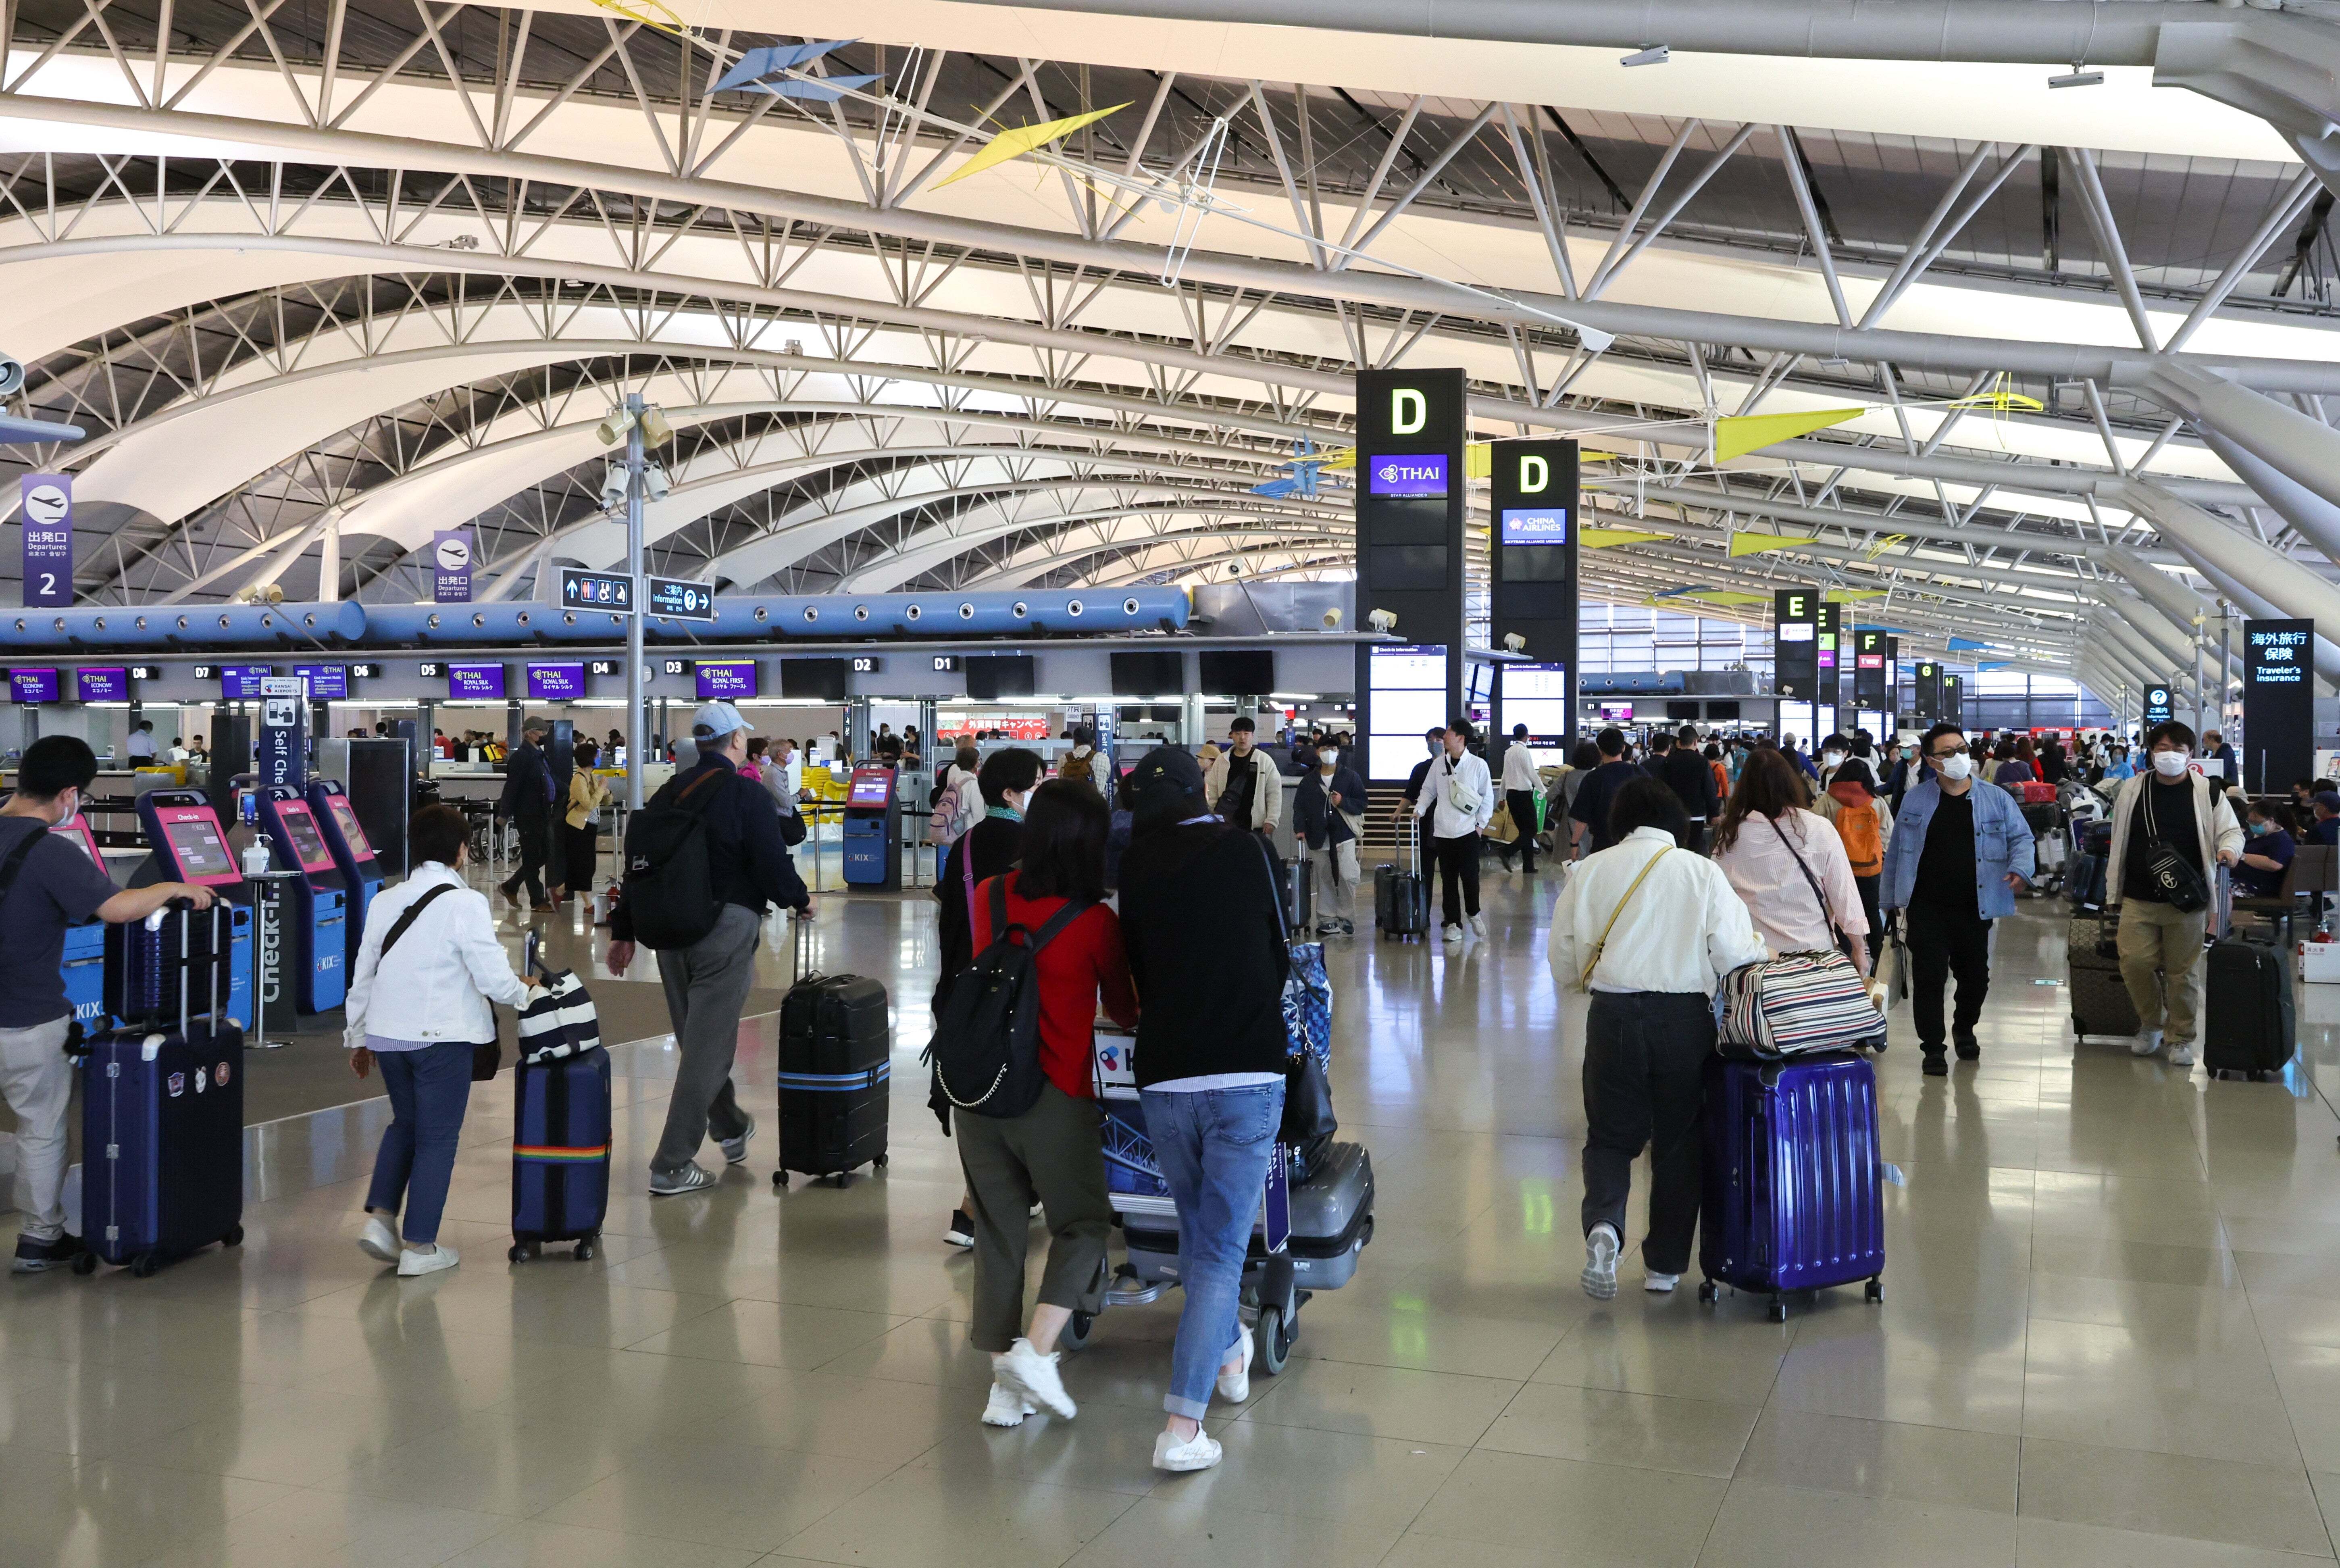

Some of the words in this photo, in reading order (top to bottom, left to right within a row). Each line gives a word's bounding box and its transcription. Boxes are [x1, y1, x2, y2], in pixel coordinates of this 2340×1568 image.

[1393, 389, 1426, 434] D
[1399, 467, 1439, 479] THAI
[1520, 456, 1548, 493] D
[28, 531, 66, 542] 出発口
[40, 573, 56, 595] 2
[439, 576, 467, 585] 出発口
[665, 585, 682, 596] ご案内
[653, 594, 682, 604] Information
[1790, 597, 1803, 616] E
[1865, 635, 1876, 650] F
[2251, 632, 2307, 645] 海外旅行
[2264, 647, 2293, 660] 保険
[421, 665, 436, 675] D5
[593, 662, 608, 673] D4
[666, 662, 681, 673] D3
[854, 659, 870, 671] D2
[935, 658, 951, 670] D1
[2257, 666, 2301, 674] Traveler's
[196, 667, 209, 677] D7
[354, 666, 368, 676] D6
[1922, 666, 1931, 677] G
[1945, 677, 1953, 687] H
[275, 731, 287, 756] Self
[275, 760, 287, 802] Chek-
[323, 956, 333, 970] KIX
[77, 1001, 100, 1020] KIX
